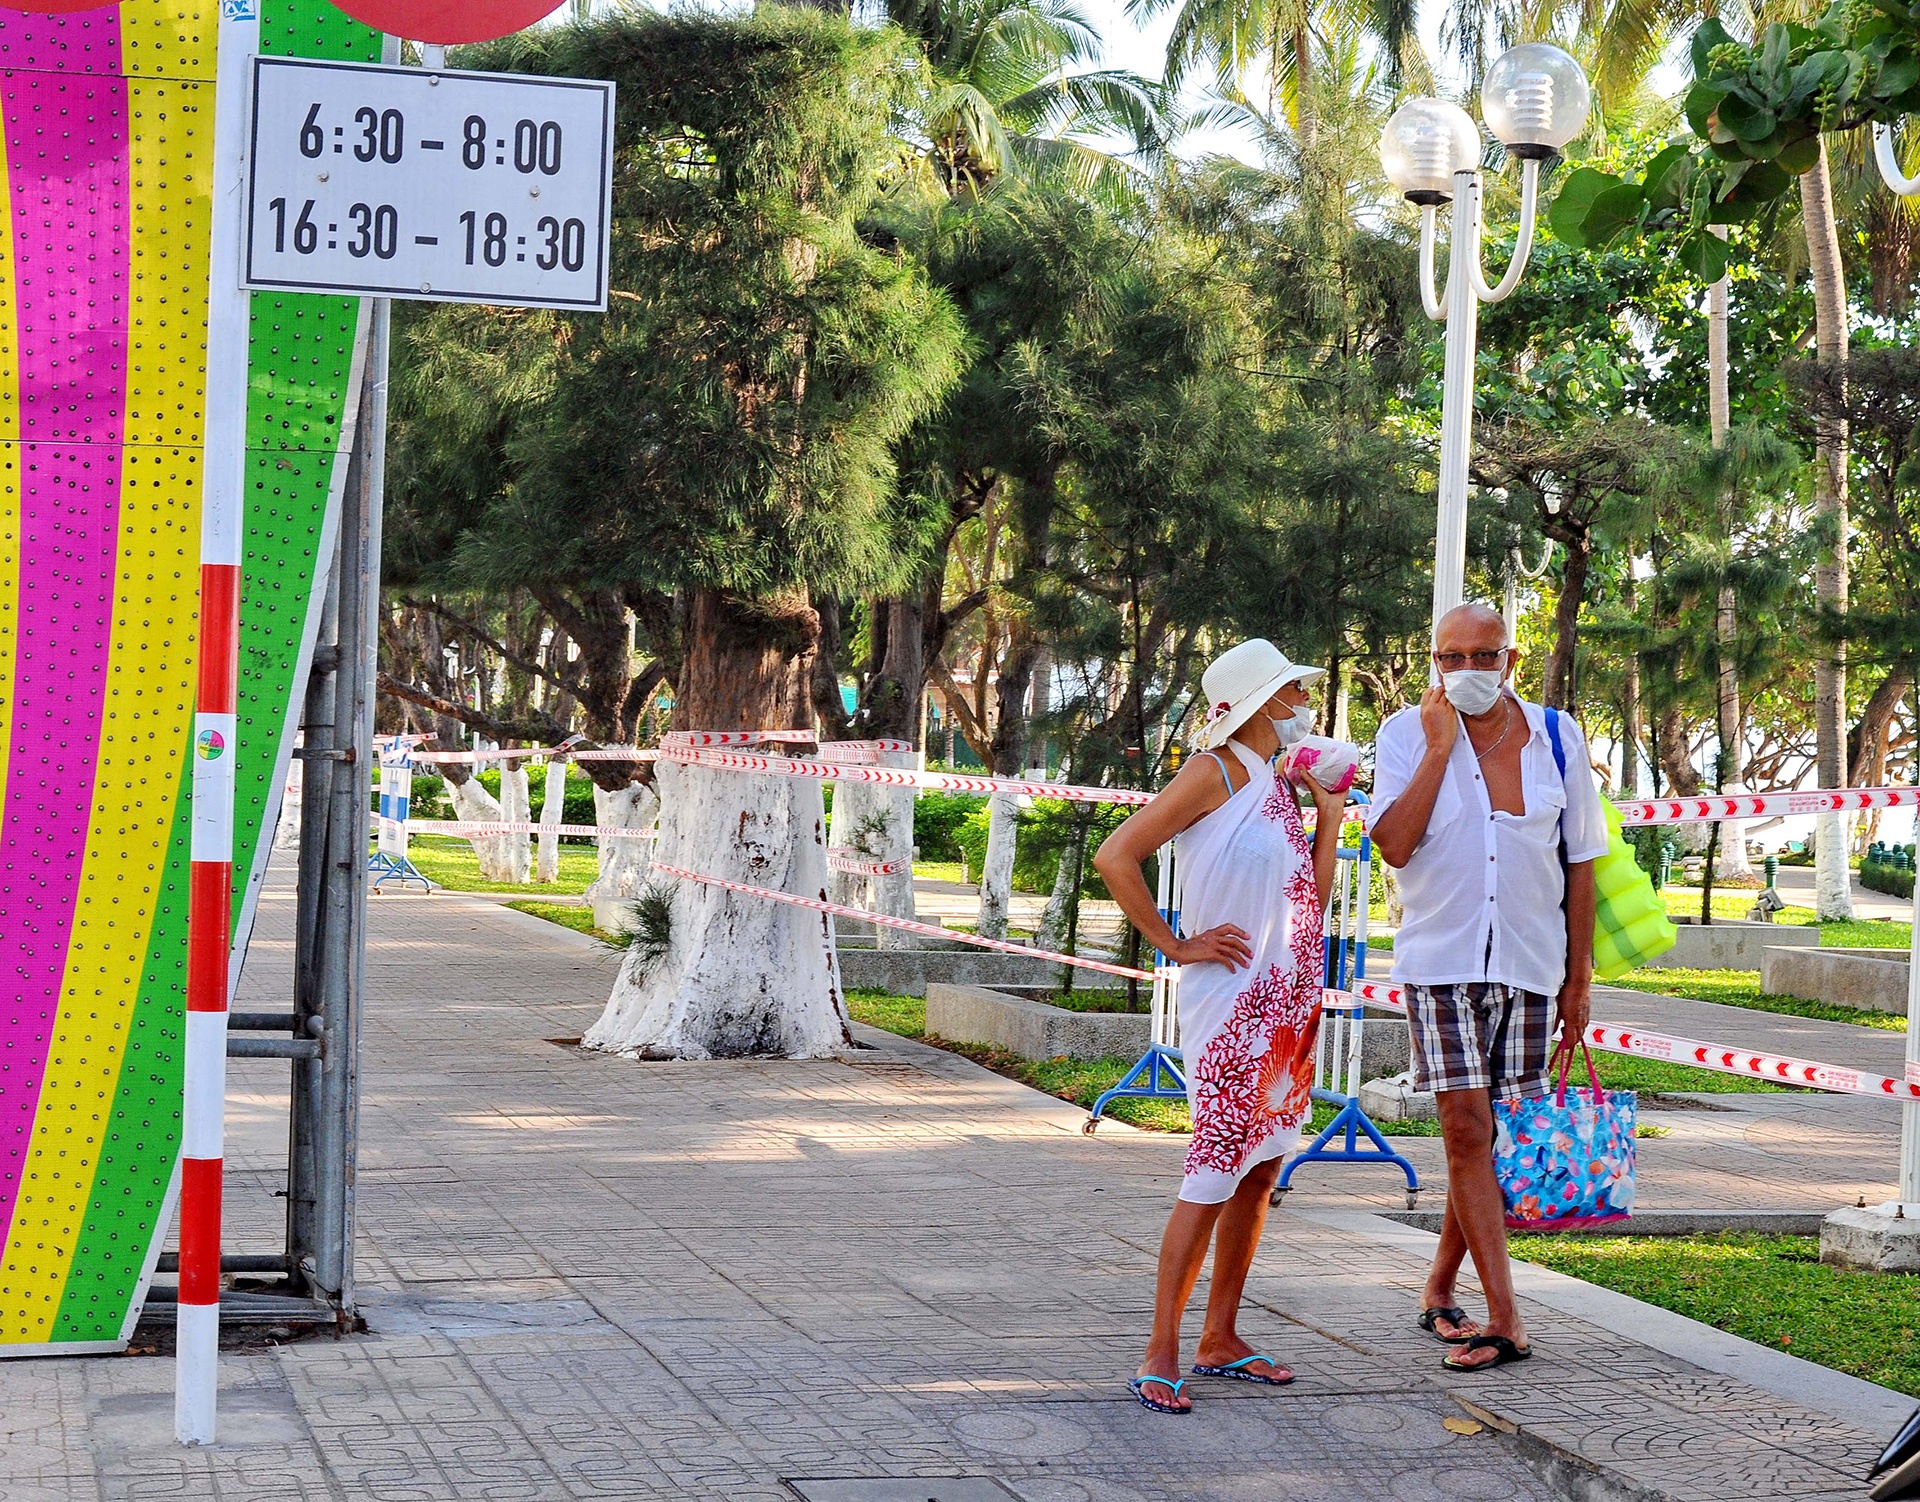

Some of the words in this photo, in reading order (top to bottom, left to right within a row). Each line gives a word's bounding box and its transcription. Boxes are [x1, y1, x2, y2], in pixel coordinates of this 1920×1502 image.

[300, 104, 403, 163] 6:30
[463, 115, 561, 175] 8:00
[270, 198, 397, 259] 16:30
[460, 211, 585, 272] 18:30
